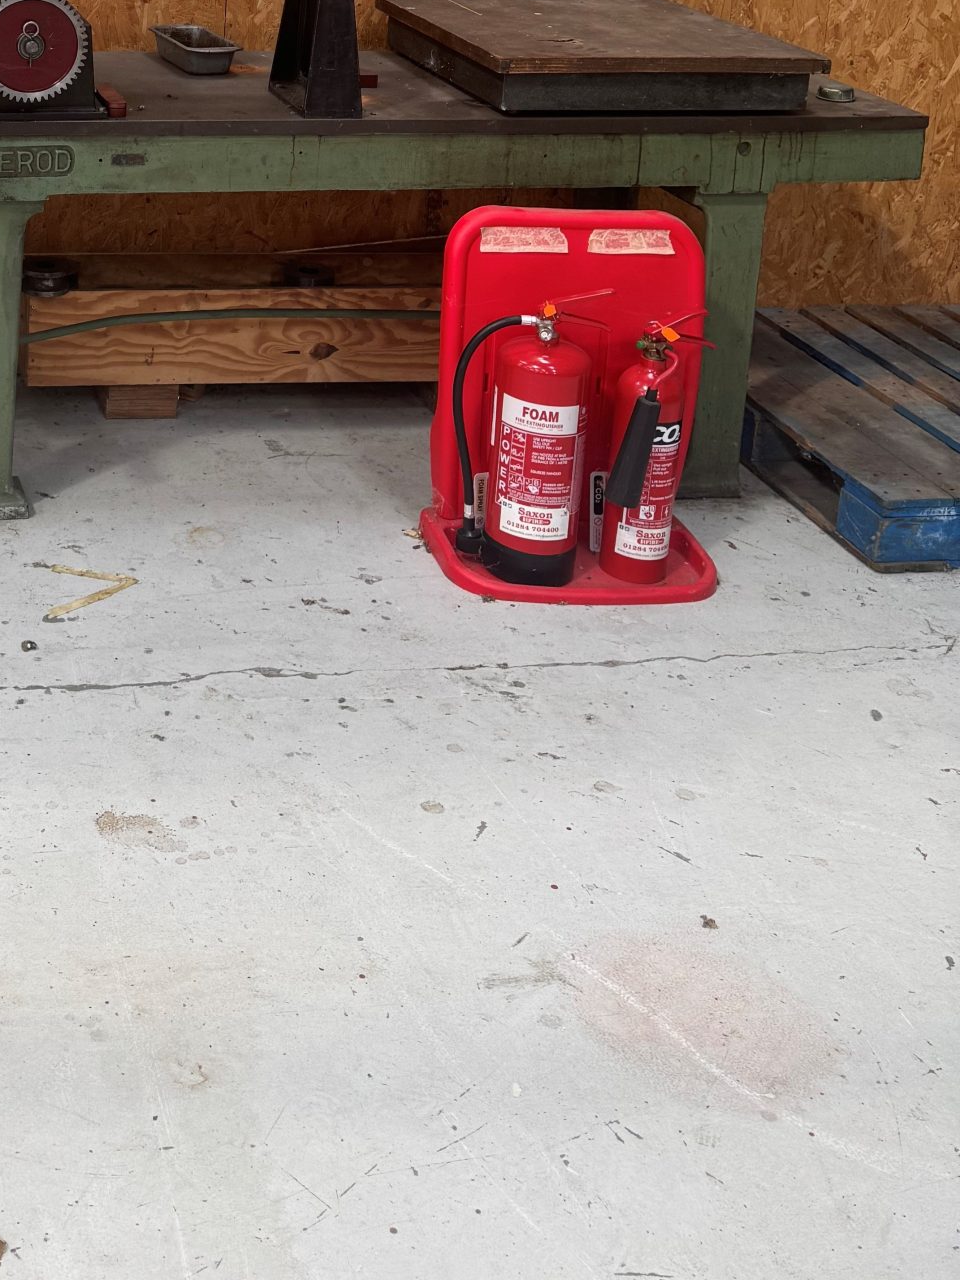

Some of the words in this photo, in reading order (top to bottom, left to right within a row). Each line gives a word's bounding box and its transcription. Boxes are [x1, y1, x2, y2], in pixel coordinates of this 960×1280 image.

[521, 406, 560, 423] FOAM
[515, 416, 526, 424] FIRE
[526, 418, 564, 429] EXTINGUISHER
[517, 506, 553, 519] Saxon
[506, 519, 530, 531] 01284
[636, 529, 667, 539] Saxon
[622, 542, 647, 553] 01284
